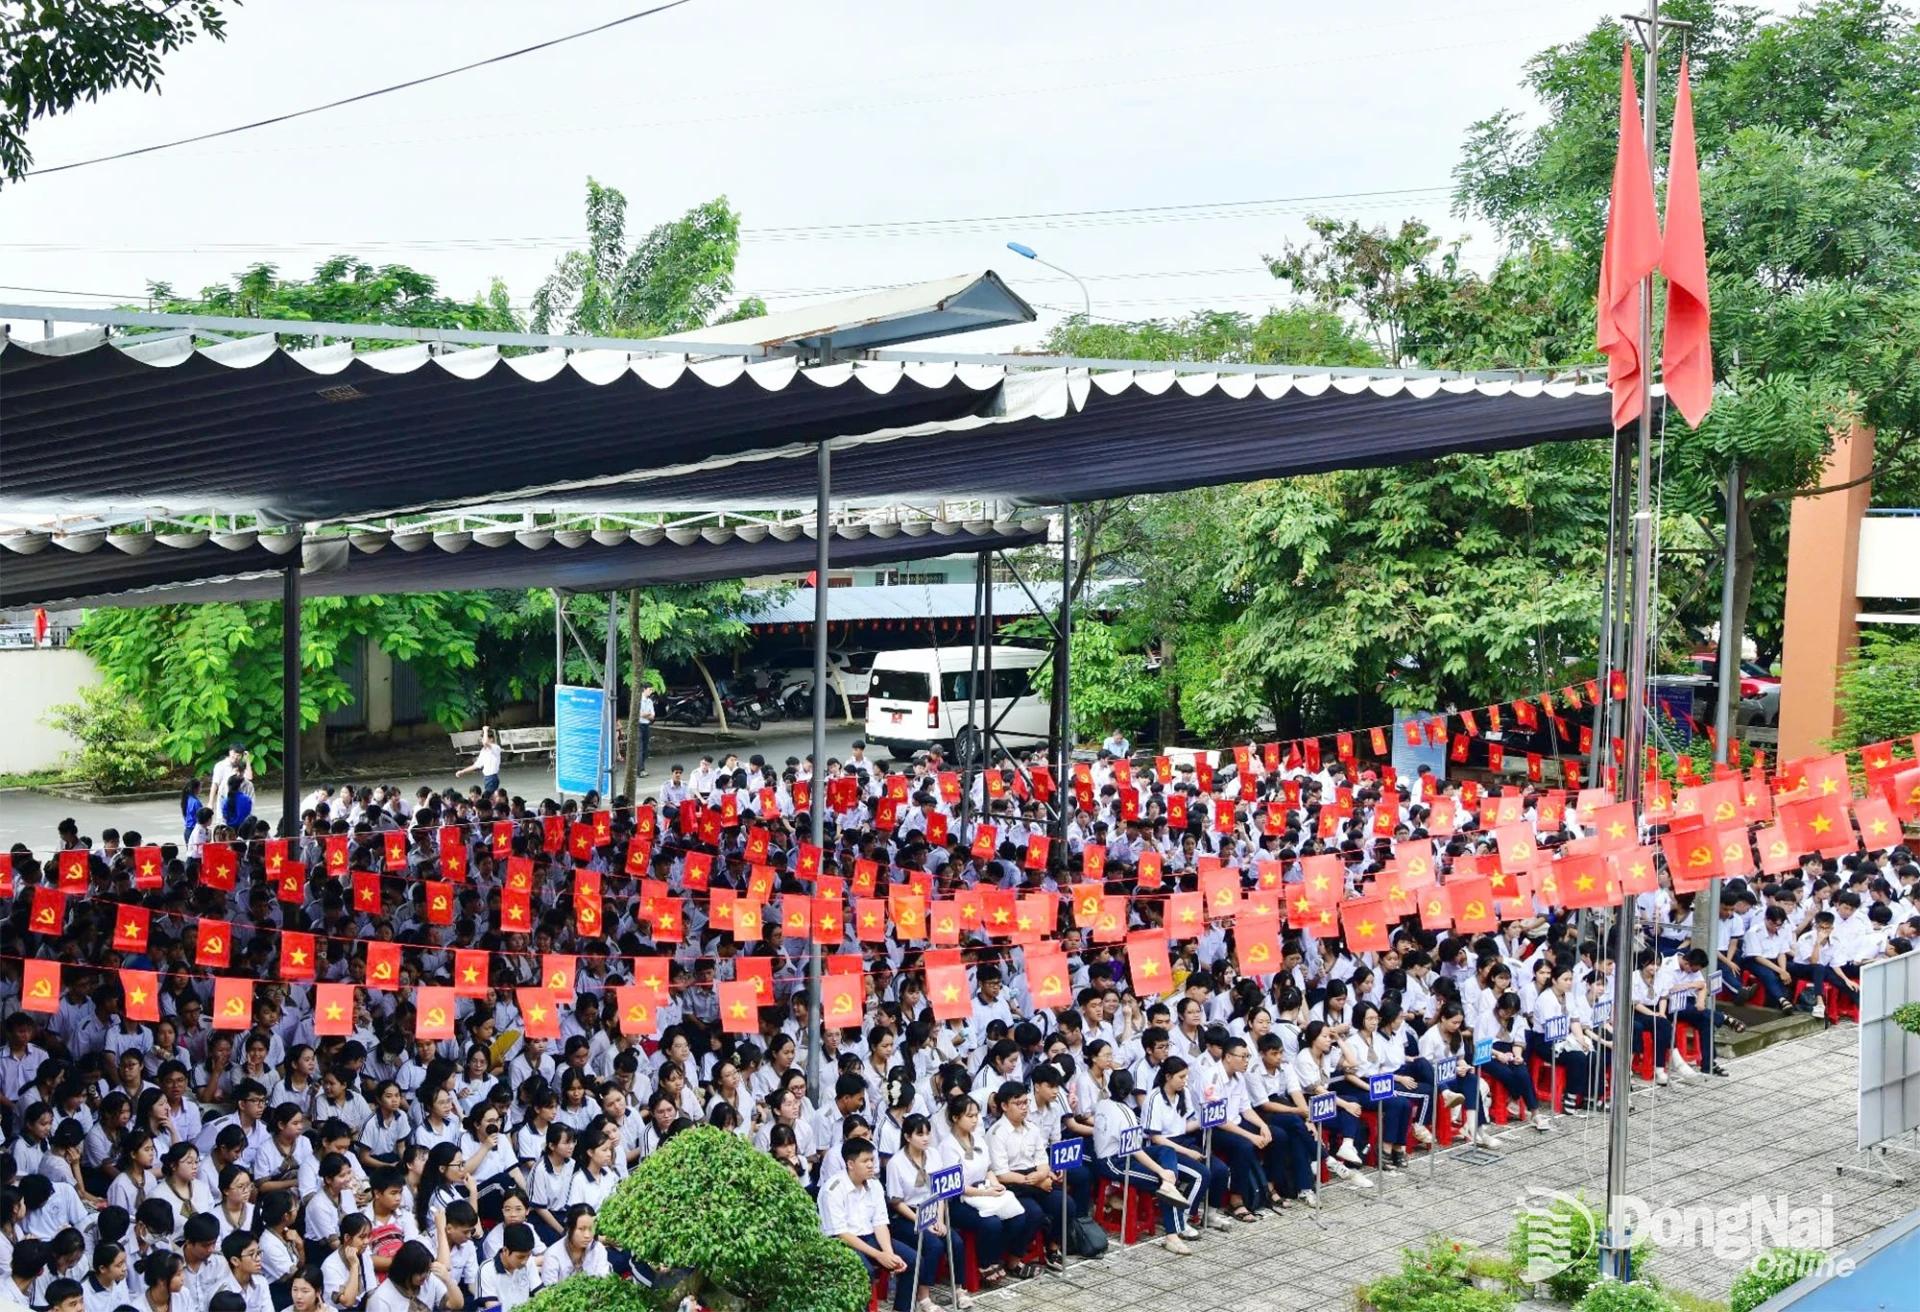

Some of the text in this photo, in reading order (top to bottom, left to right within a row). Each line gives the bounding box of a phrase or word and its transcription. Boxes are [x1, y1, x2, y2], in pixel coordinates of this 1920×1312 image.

[1438, 1060, 1456, 1082] 12A2
[1373, 1079, 1391, 1094] 12A3
[1203, 1104, 1225, 1123] 12A5
[1313, 1098, 1334, 1117] 12A4
[1121, 1129, 1142, 1154] 12A6
[1054, 1144, 1081, 1165] 12A7
[934, 1171, 961, 1195] 12A8
[920, 1200, 938, 1223] 12A9
